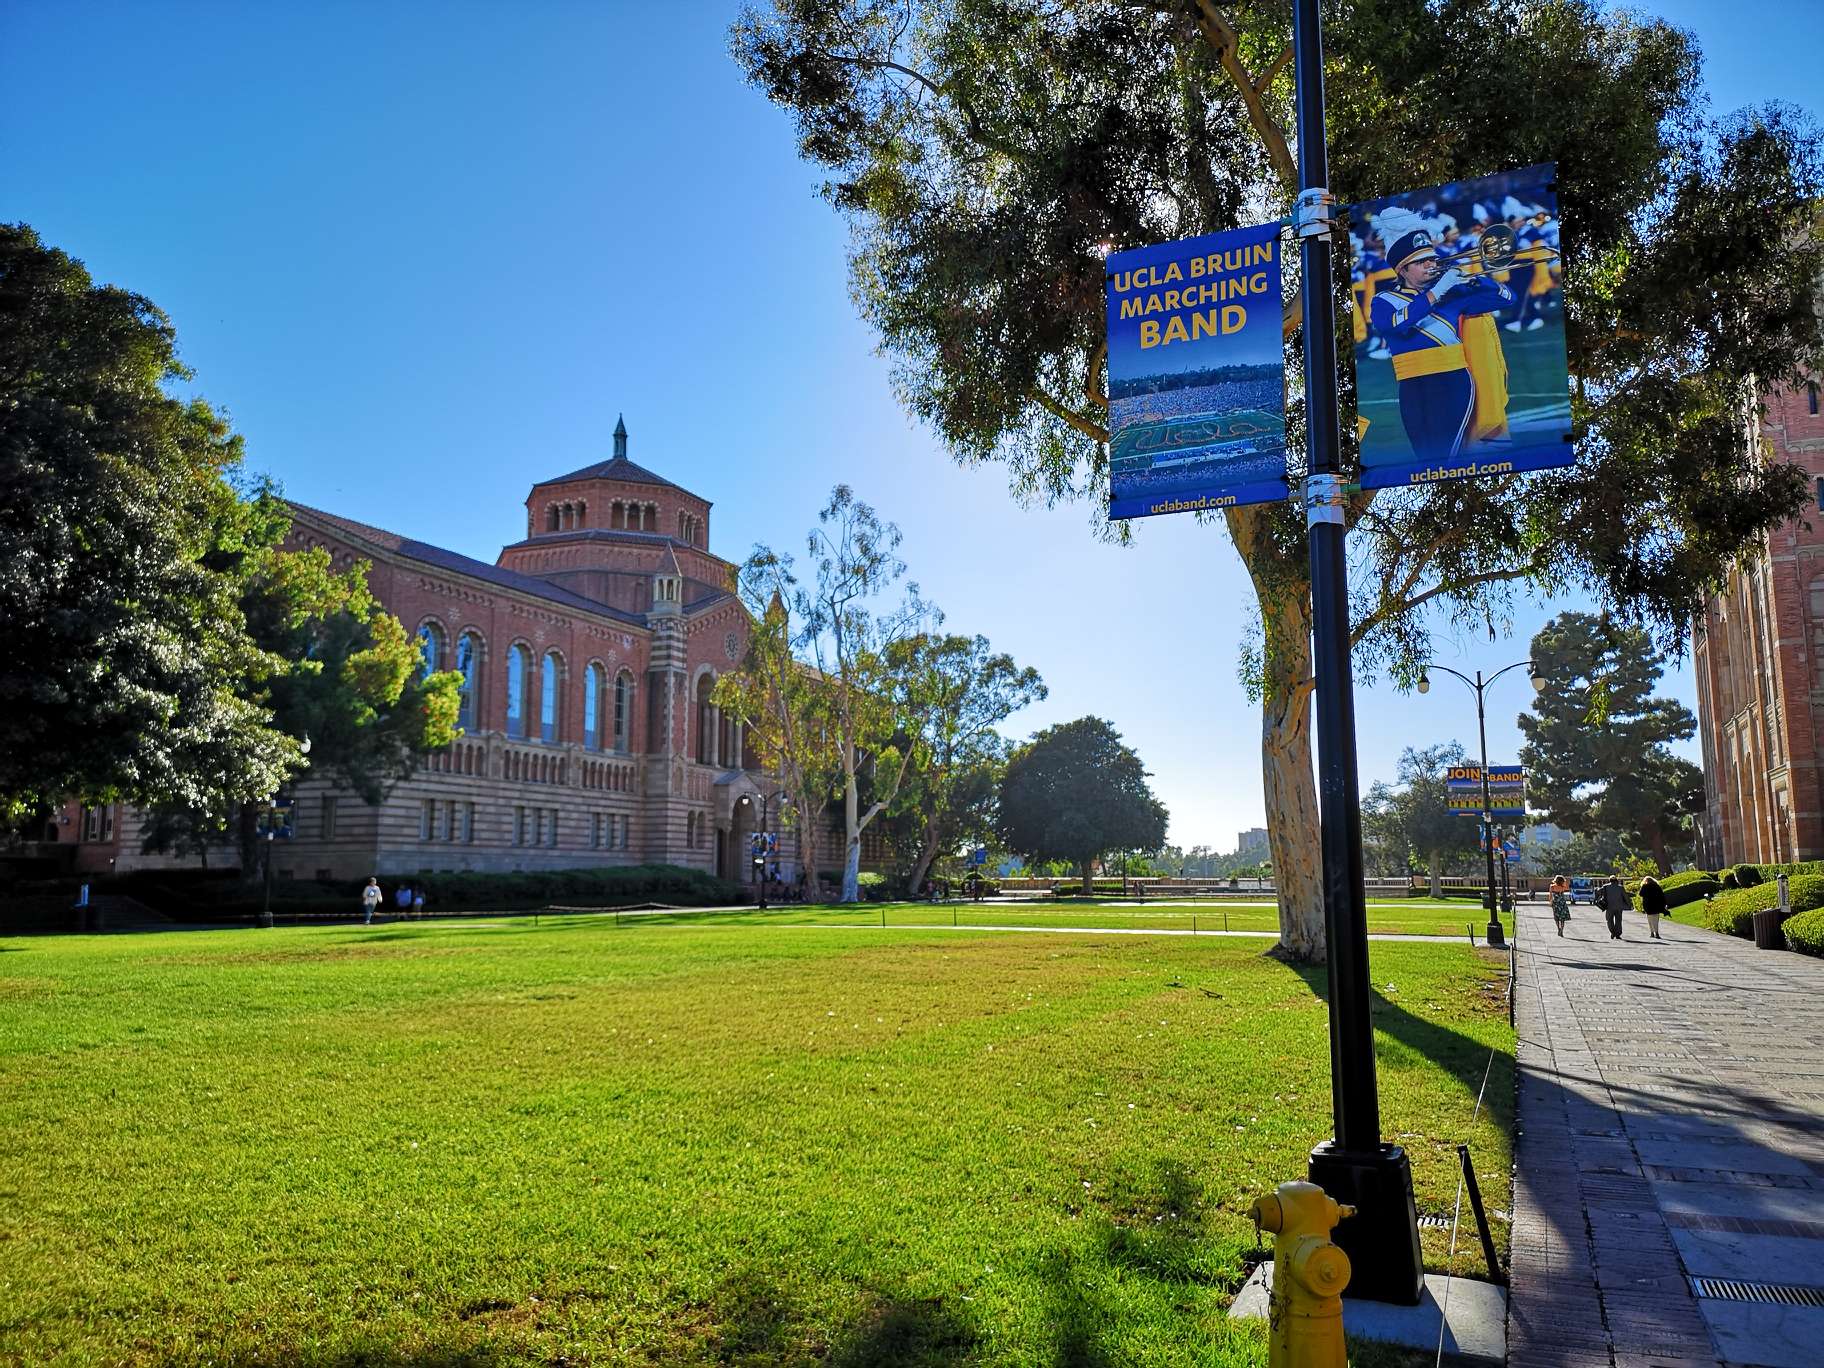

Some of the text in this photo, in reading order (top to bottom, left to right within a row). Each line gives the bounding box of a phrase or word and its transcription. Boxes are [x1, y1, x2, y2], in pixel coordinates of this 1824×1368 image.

[1114, 241, 1273, 293] UCLA BRUIN
[1119, 272, 1268, 320] MARCHING
[1140, 304, 1248, 350] BAND
[1410, 461, 1512, 482] uclaband.com
[1150, 495, 1237, 513] uclaband.com
[1448, 768, 1480, 779] JOIN
